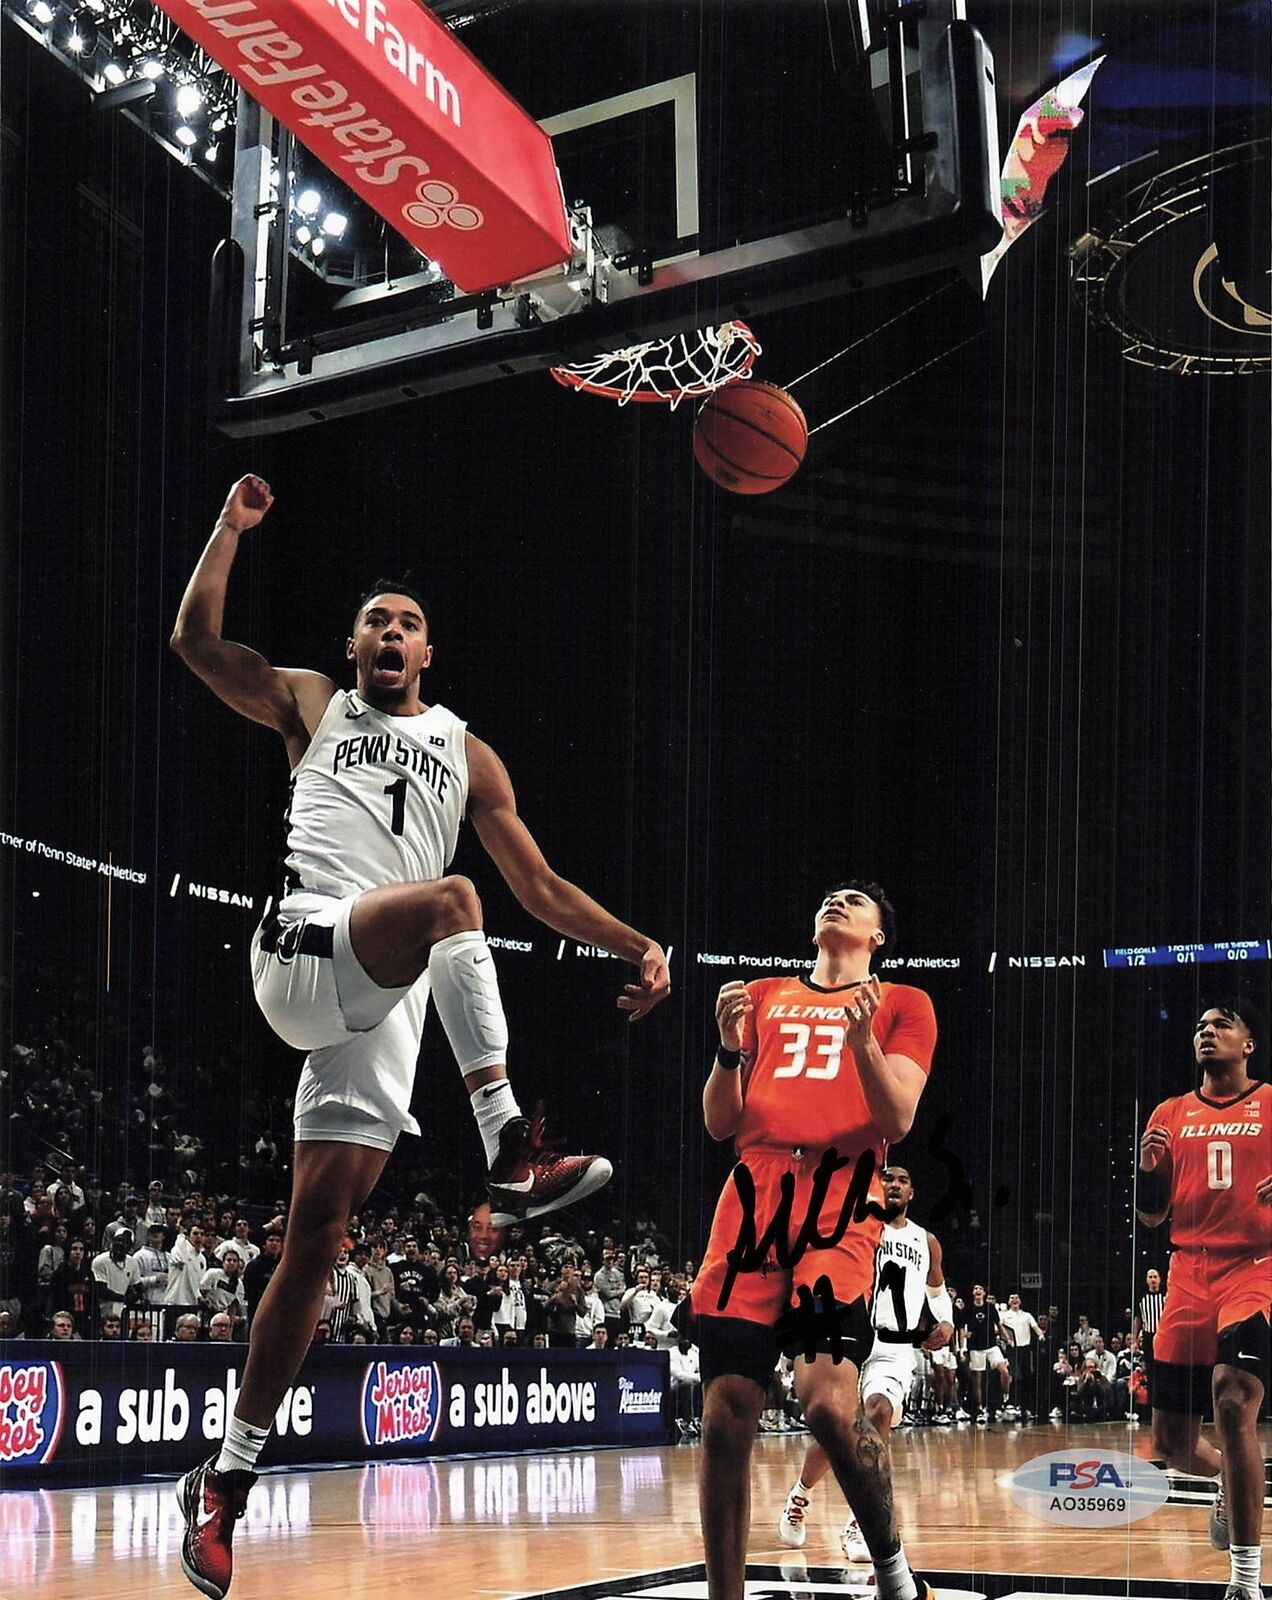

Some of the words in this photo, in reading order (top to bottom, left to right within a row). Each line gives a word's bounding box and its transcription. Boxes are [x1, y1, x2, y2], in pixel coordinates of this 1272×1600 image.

[333, 733, 391, 775] PENN
[395, 738, 452, 805] STATE
[383, 778, 408, 836] 1
[25, 839, 37, 853] of
[38, 842, 65, 861] Penn
[189, 882, 253, 909] NISSAN
[576, 945, 619, 959] NIS
[738, 954, 773, 967] Proud
[1008, 954, 1086, 968] NISSAN
[1126, 954, 1146, 967] 1/2
[1176, 951, 1195, 963] 0/1
[1227, 949, 1248, 960] 0/0
[773, 1022, 845, 1080] 33
[1180, 1122, 1263, 1138] ILLINOIS
[1207, 1140, 1233, 1190] 0
[896, 1241, 922, 1271] STATE
[372, 1362, 432, 1404] Jersey
[76, 1389, 103, 1446] a
[116, 1368, 190, 1445] sub
[449, 1384, 466, 1428] a
[474, 1368, 519, 1428] sub
[526, 1368, 596, 1425] above
